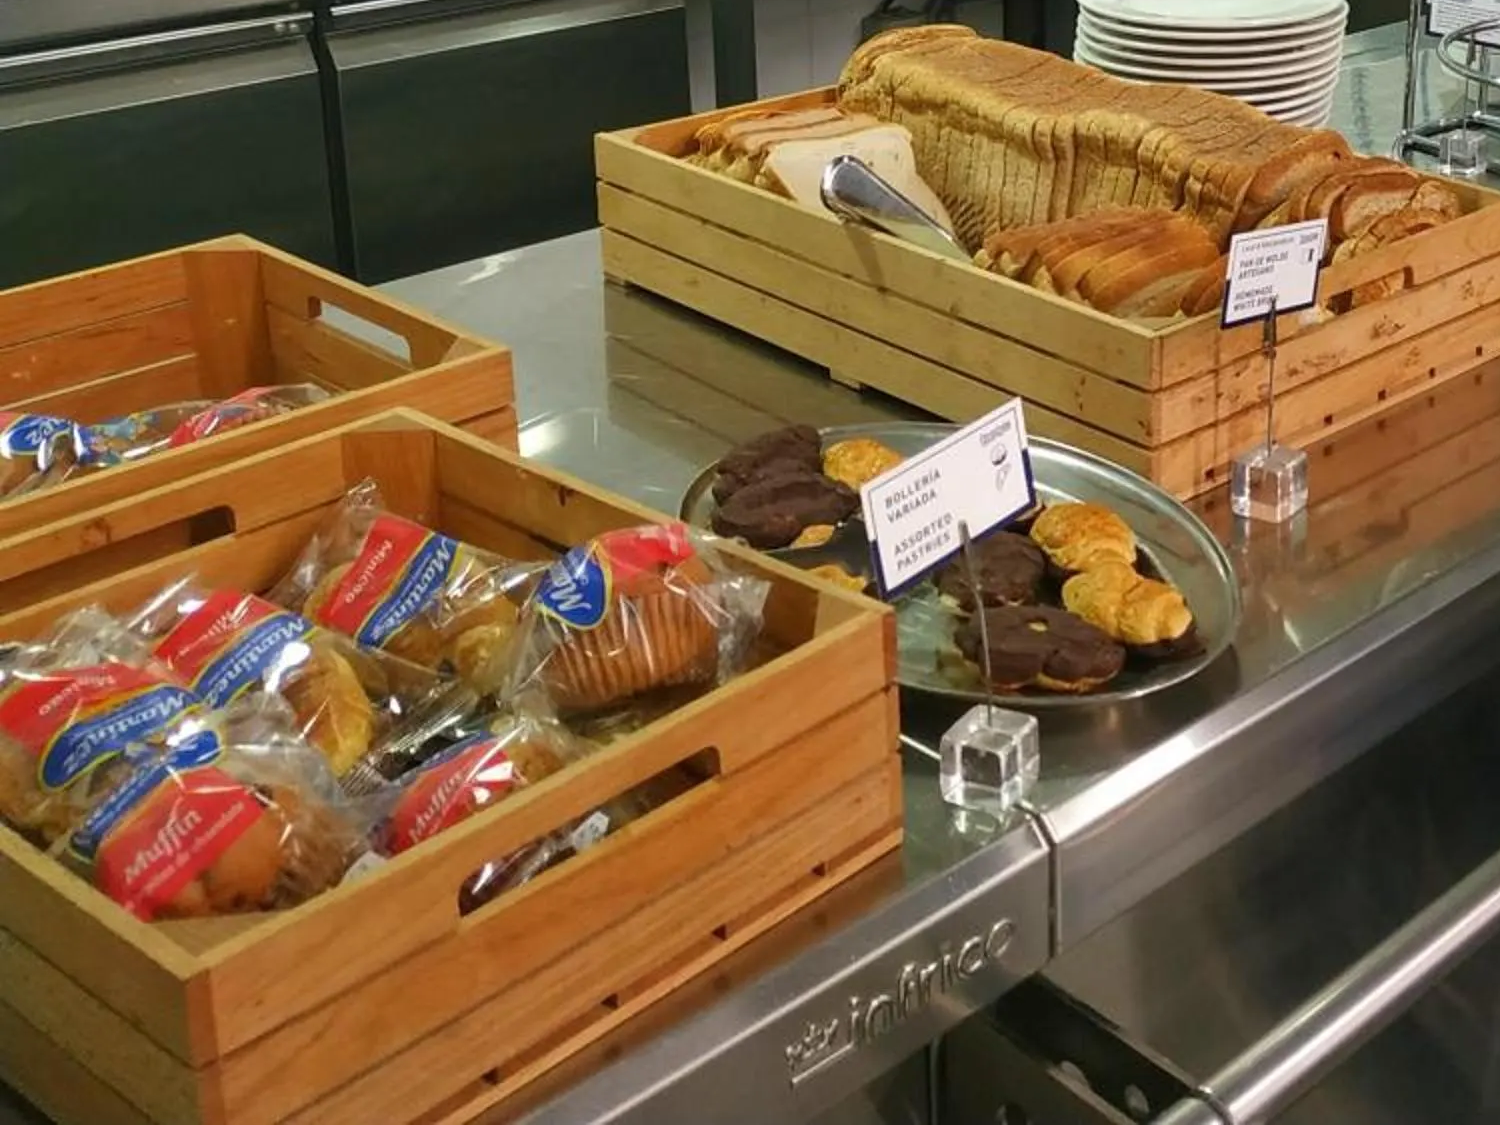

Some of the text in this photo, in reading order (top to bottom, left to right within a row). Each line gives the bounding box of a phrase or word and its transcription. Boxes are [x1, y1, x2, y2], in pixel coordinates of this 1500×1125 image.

[884, 467, 941, 509] BOLLERÍA
[887, 489, 937, 524] VARIADA
[893, 512, 954, 555] ASSORTED
[896, 531, 951, 572] PASTRIES
[124, 809, 203, 885] Muffin
[849, 917, 1016, 1048] infrico
